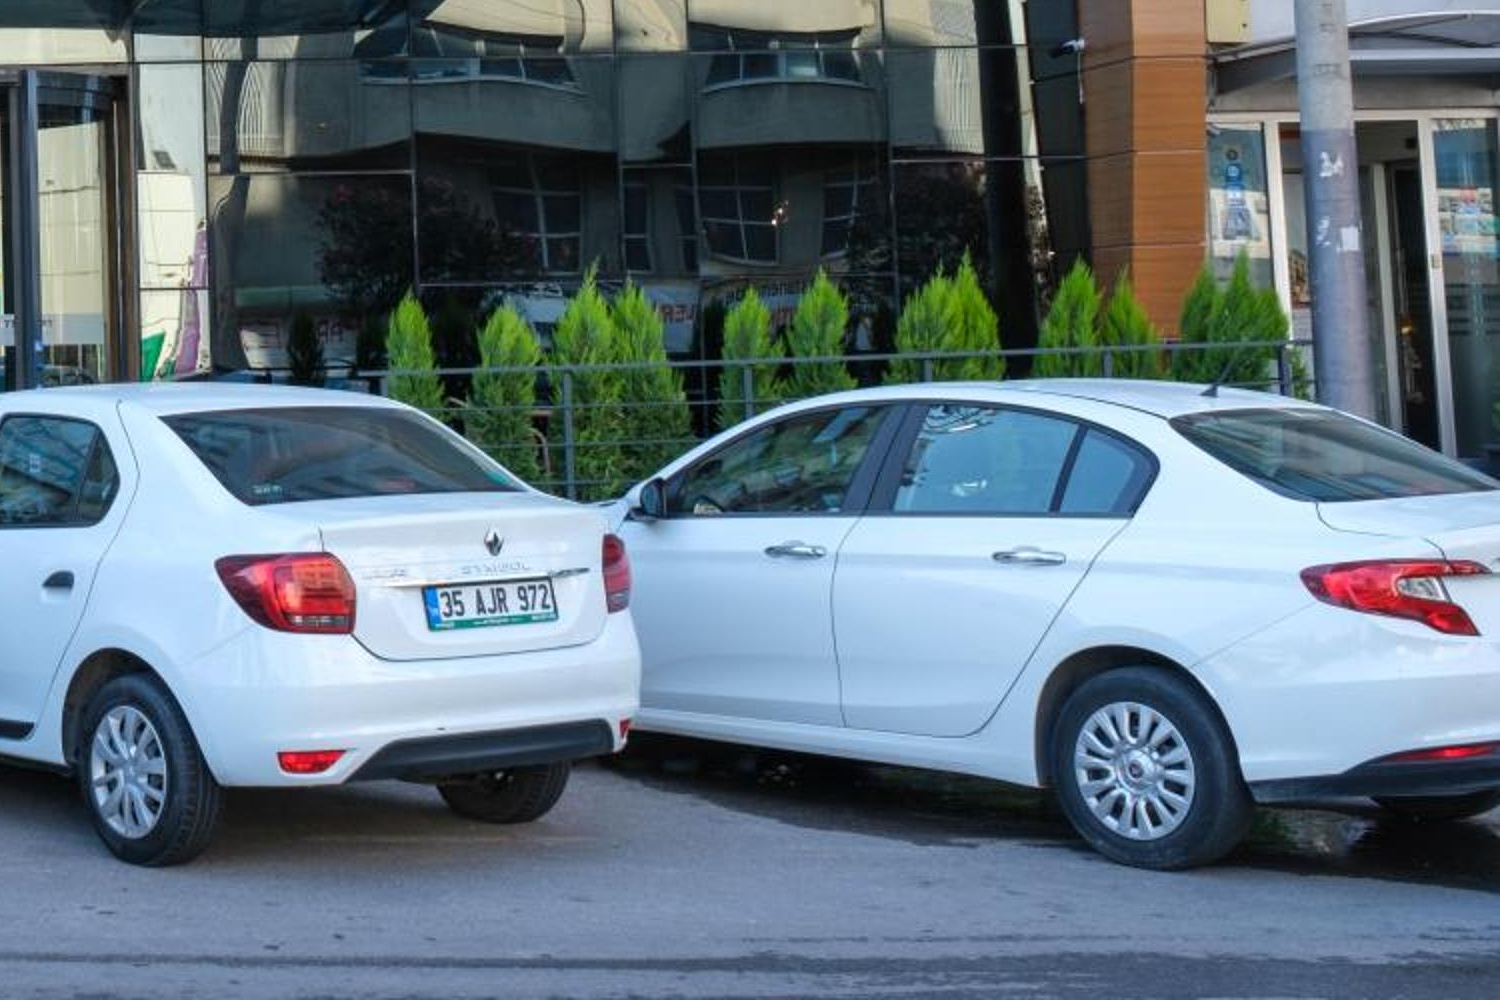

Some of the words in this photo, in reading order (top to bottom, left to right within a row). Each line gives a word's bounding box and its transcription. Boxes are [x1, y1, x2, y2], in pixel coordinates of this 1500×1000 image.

[440, 591, 465, 617] 35
[475, 588, 509, 615] AJR
[517, 584, 551, 611] 972
